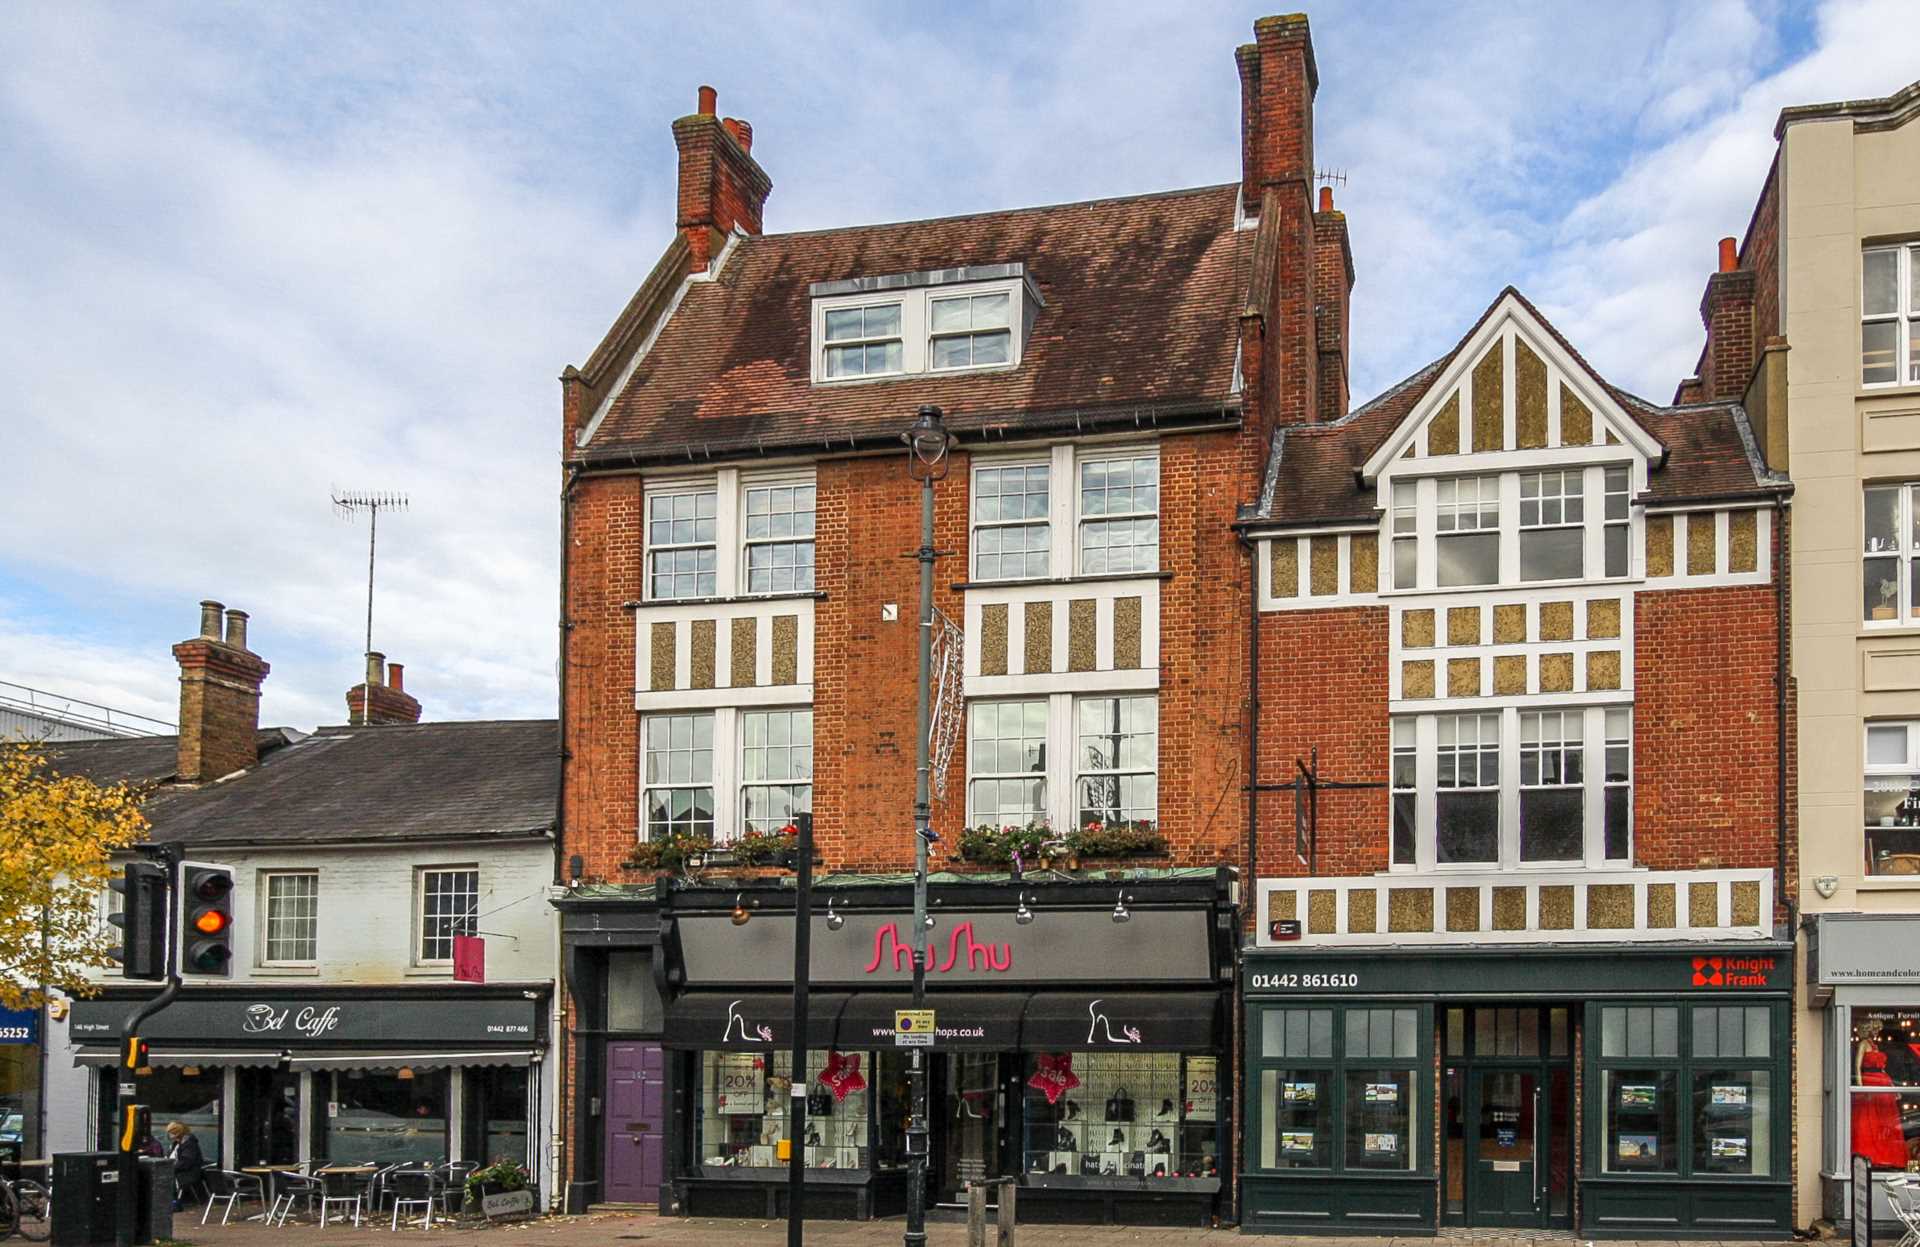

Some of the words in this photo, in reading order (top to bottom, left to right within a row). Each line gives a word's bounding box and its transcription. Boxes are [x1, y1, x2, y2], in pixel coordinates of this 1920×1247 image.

[1904, 797, 1920, 809] Fi
[938, 920, 1012, 972] Shu
[1726, 957, 1776, 973] Knight
[1252, 974, 1298, 987] 01442
[1302, 974, 1358, 987] 861610
[1726, 972, 1768, 986] Frank
[243, 1004, 289, 1032] Bel
[726, 1075, 756, 1088] 20%
